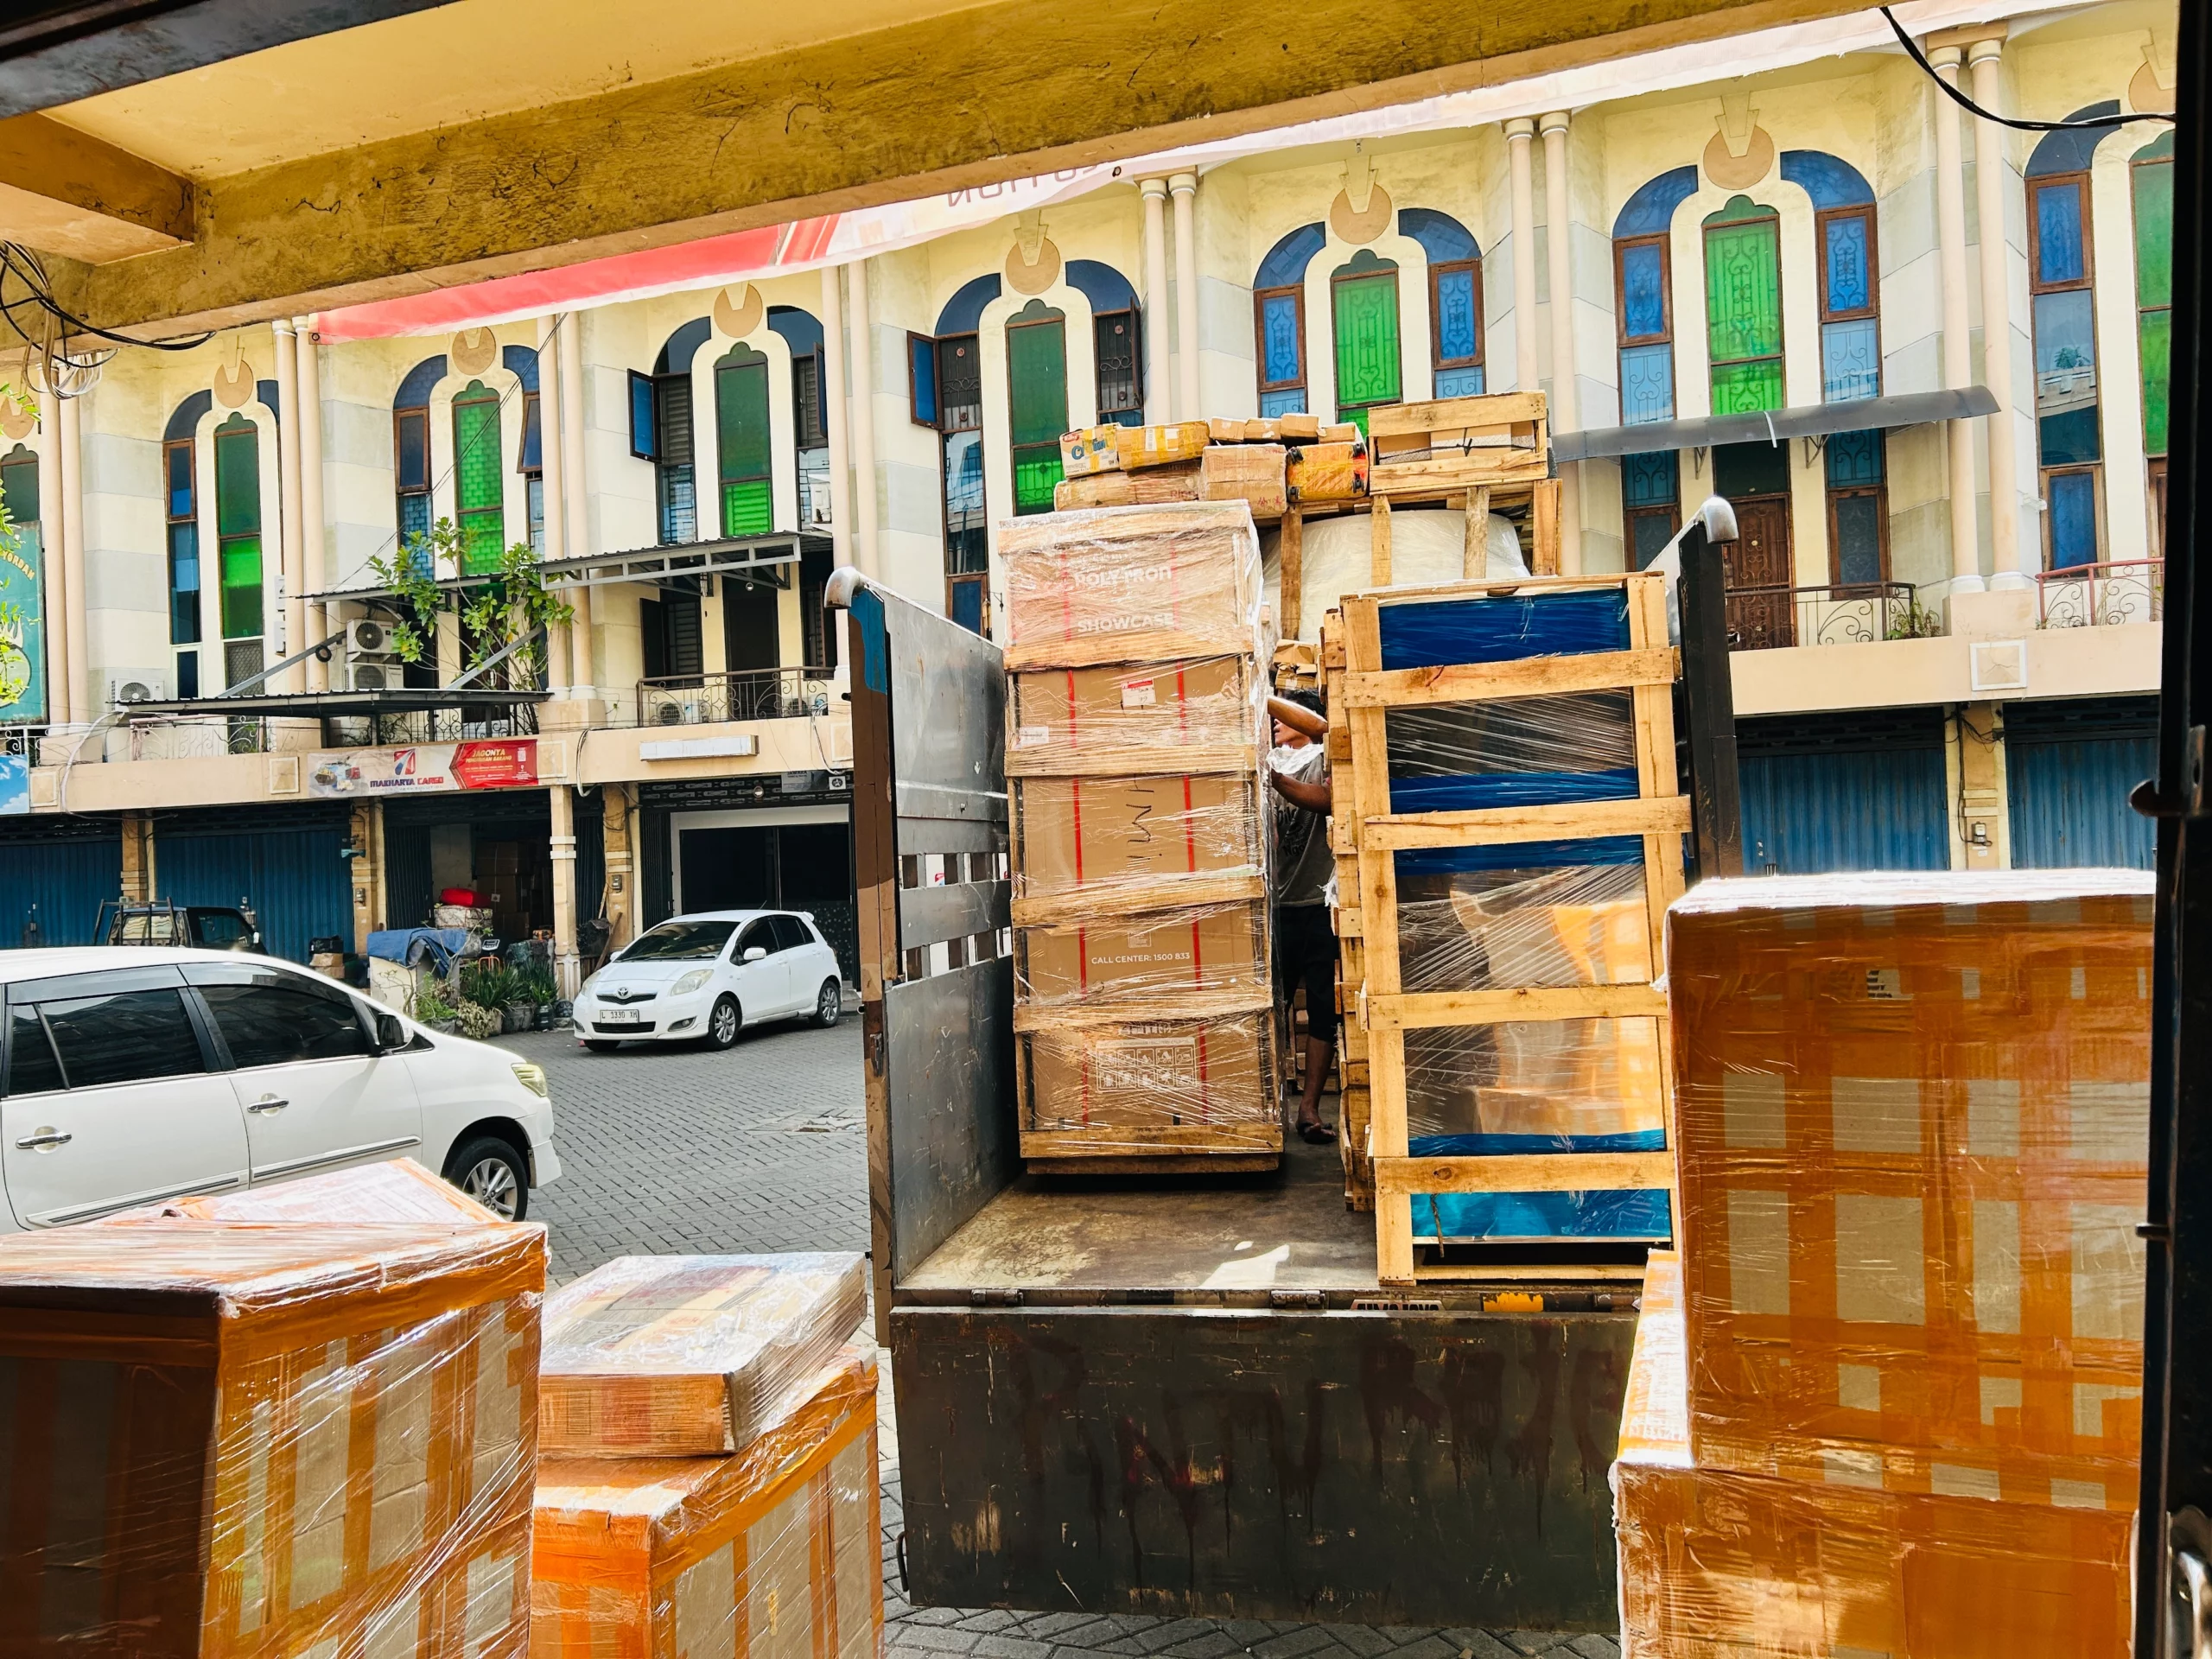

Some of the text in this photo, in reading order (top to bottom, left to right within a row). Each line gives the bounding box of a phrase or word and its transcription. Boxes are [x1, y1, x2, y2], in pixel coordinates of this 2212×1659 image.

[1077, 613, 1174, 632] SHOWCASE
[473, 748, 505, 758] JAGONYA
[370, 776, 444, 787] MAKHARYA CARGO
[1116, 954, 1152, 963] CENTER:
[1174, 951, 1190, 960] 833
